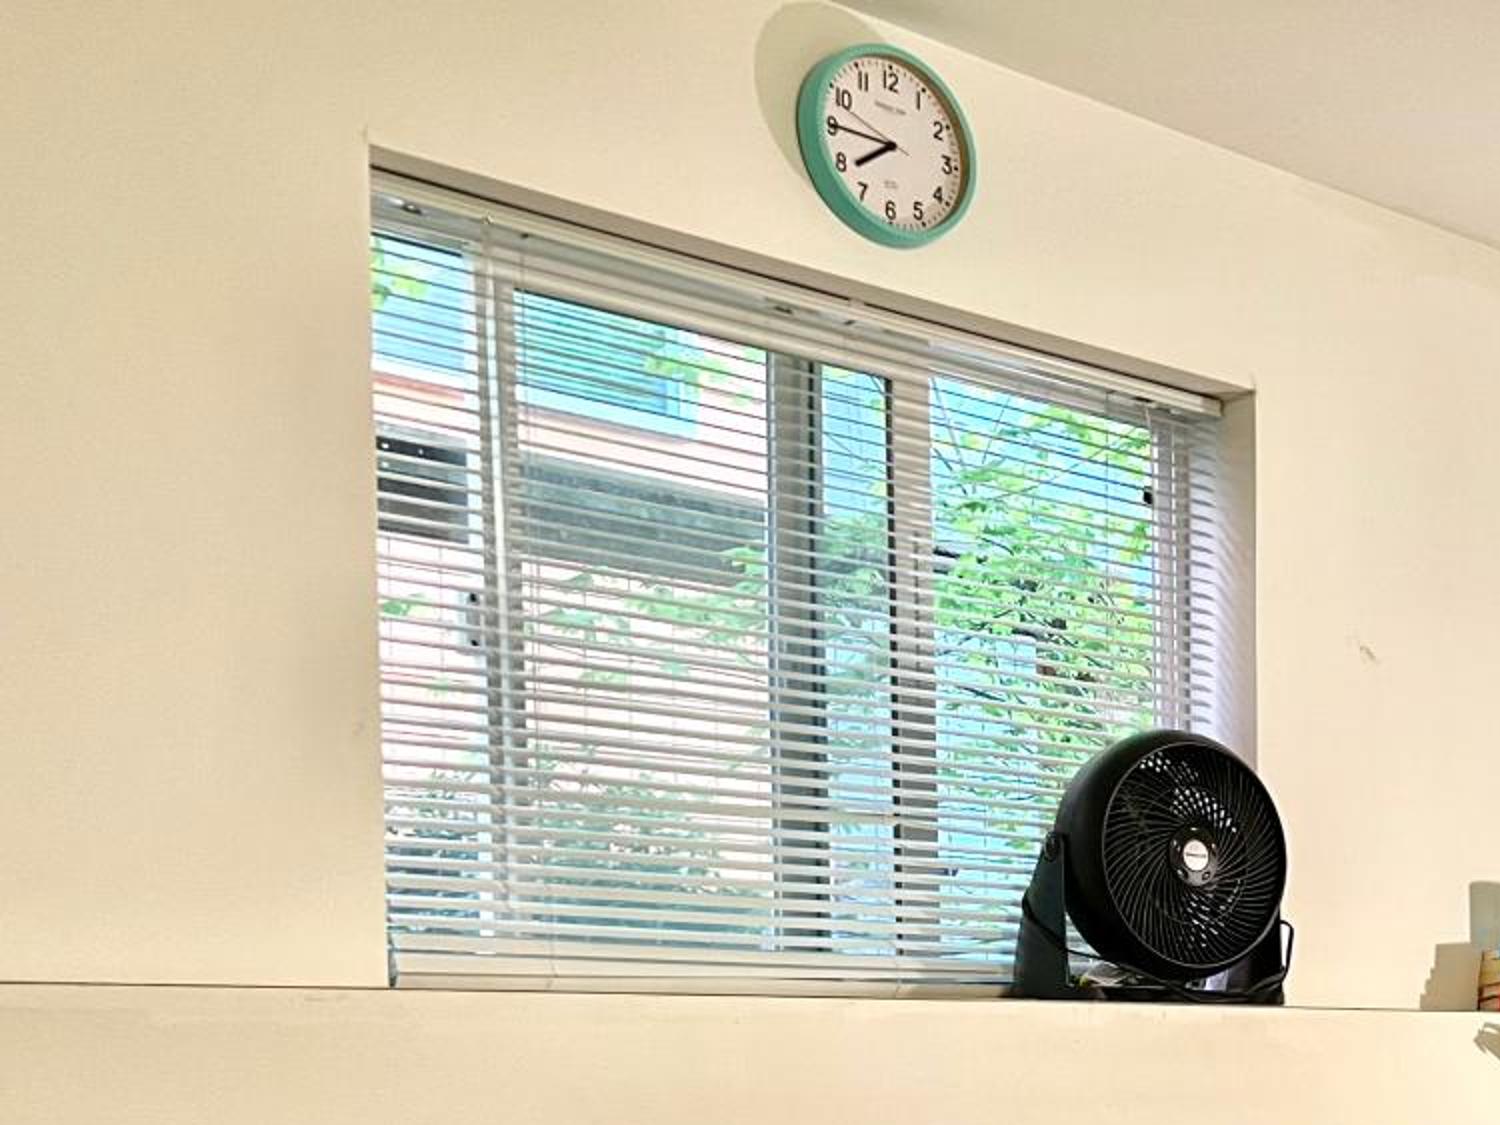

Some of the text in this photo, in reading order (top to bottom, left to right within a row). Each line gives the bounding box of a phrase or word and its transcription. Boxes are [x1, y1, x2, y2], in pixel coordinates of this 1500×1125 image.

[857, 71, 869, 92] 11
[882, 70, 899, 93] 12
[835, 87, 853, 110] 10
[915, 92, 921, 110] 1
[826, 115, 839, 136] 9
[932, 121, 944, 141] 2
[834, 152, 847, 173] 8
[941, 154, 953, 175] 3
[856, 181, 868, 201] 7
[932, 186, 943, 203] 4
[884, 201, 897, 220] 6
[912, 201, 924, 221] 5
